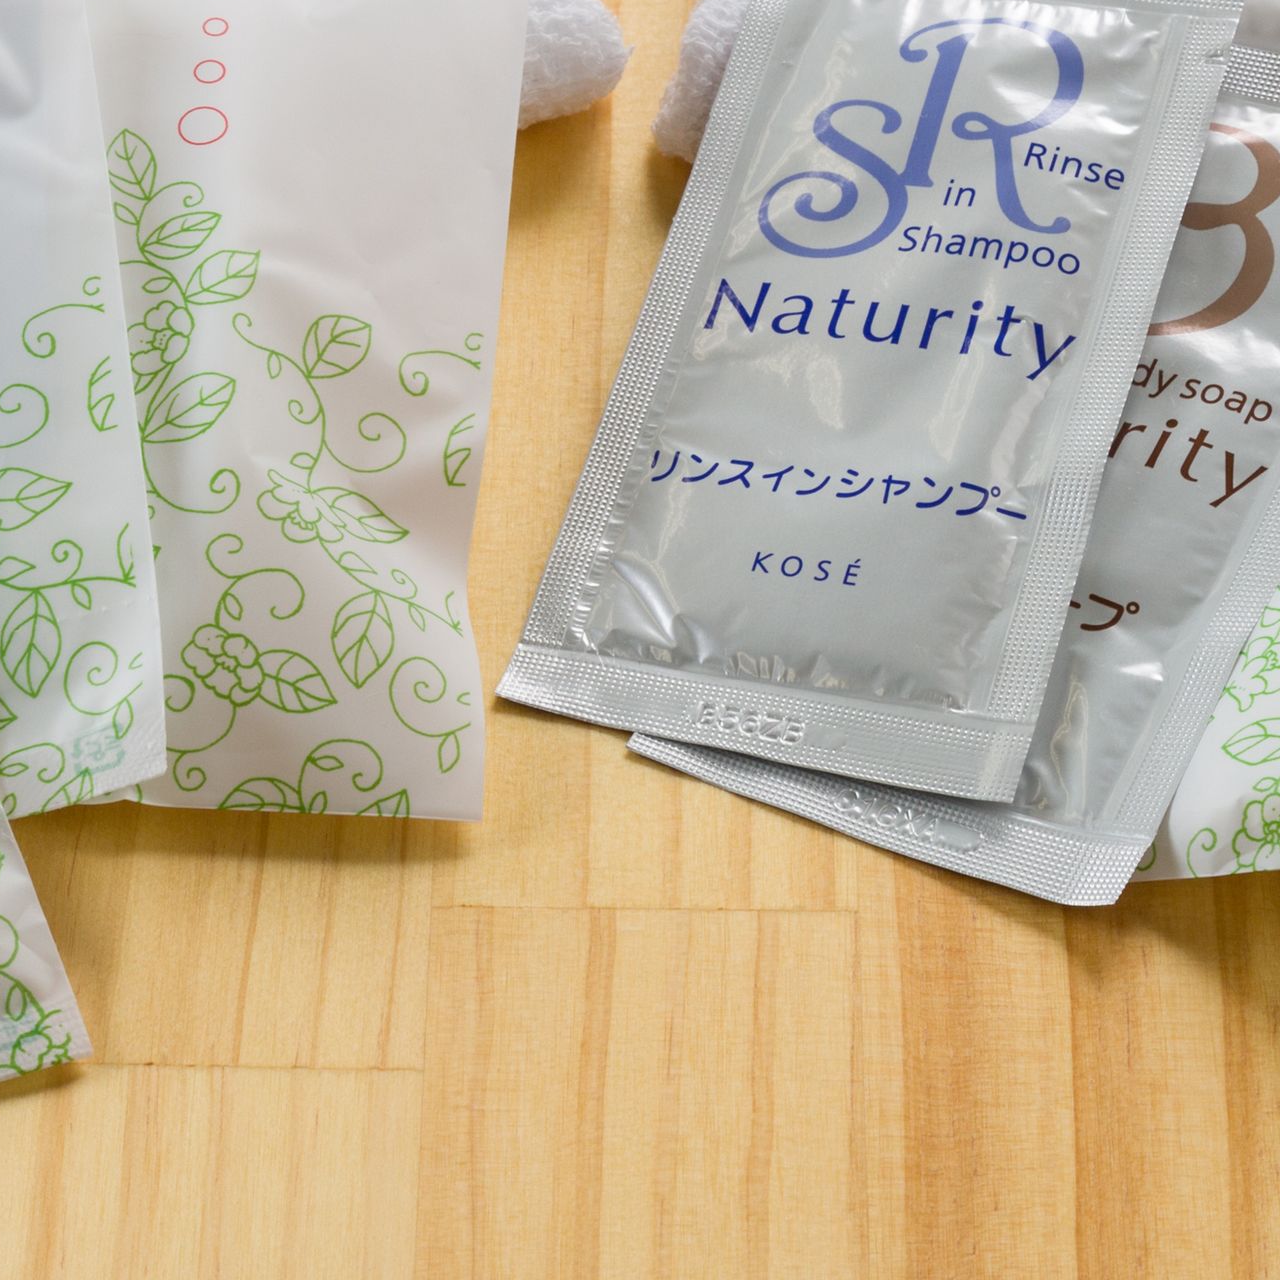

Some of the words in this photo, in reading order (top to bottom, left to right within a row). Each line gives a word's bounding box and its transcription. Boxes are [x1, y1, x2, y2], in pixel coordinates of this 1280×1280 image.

[1024, 142, 1126, 192] Rinse
[943, 179, 976, 208] in
[898, 227, 1081, 276] Shampoo
[702, 277, 1077, 380] Naturity
[1179, 378, 1273, 424] soap
[650, 450, 1028, 520] リンスインシャンプー
[751, 550, 862, 588] KOSÉ
